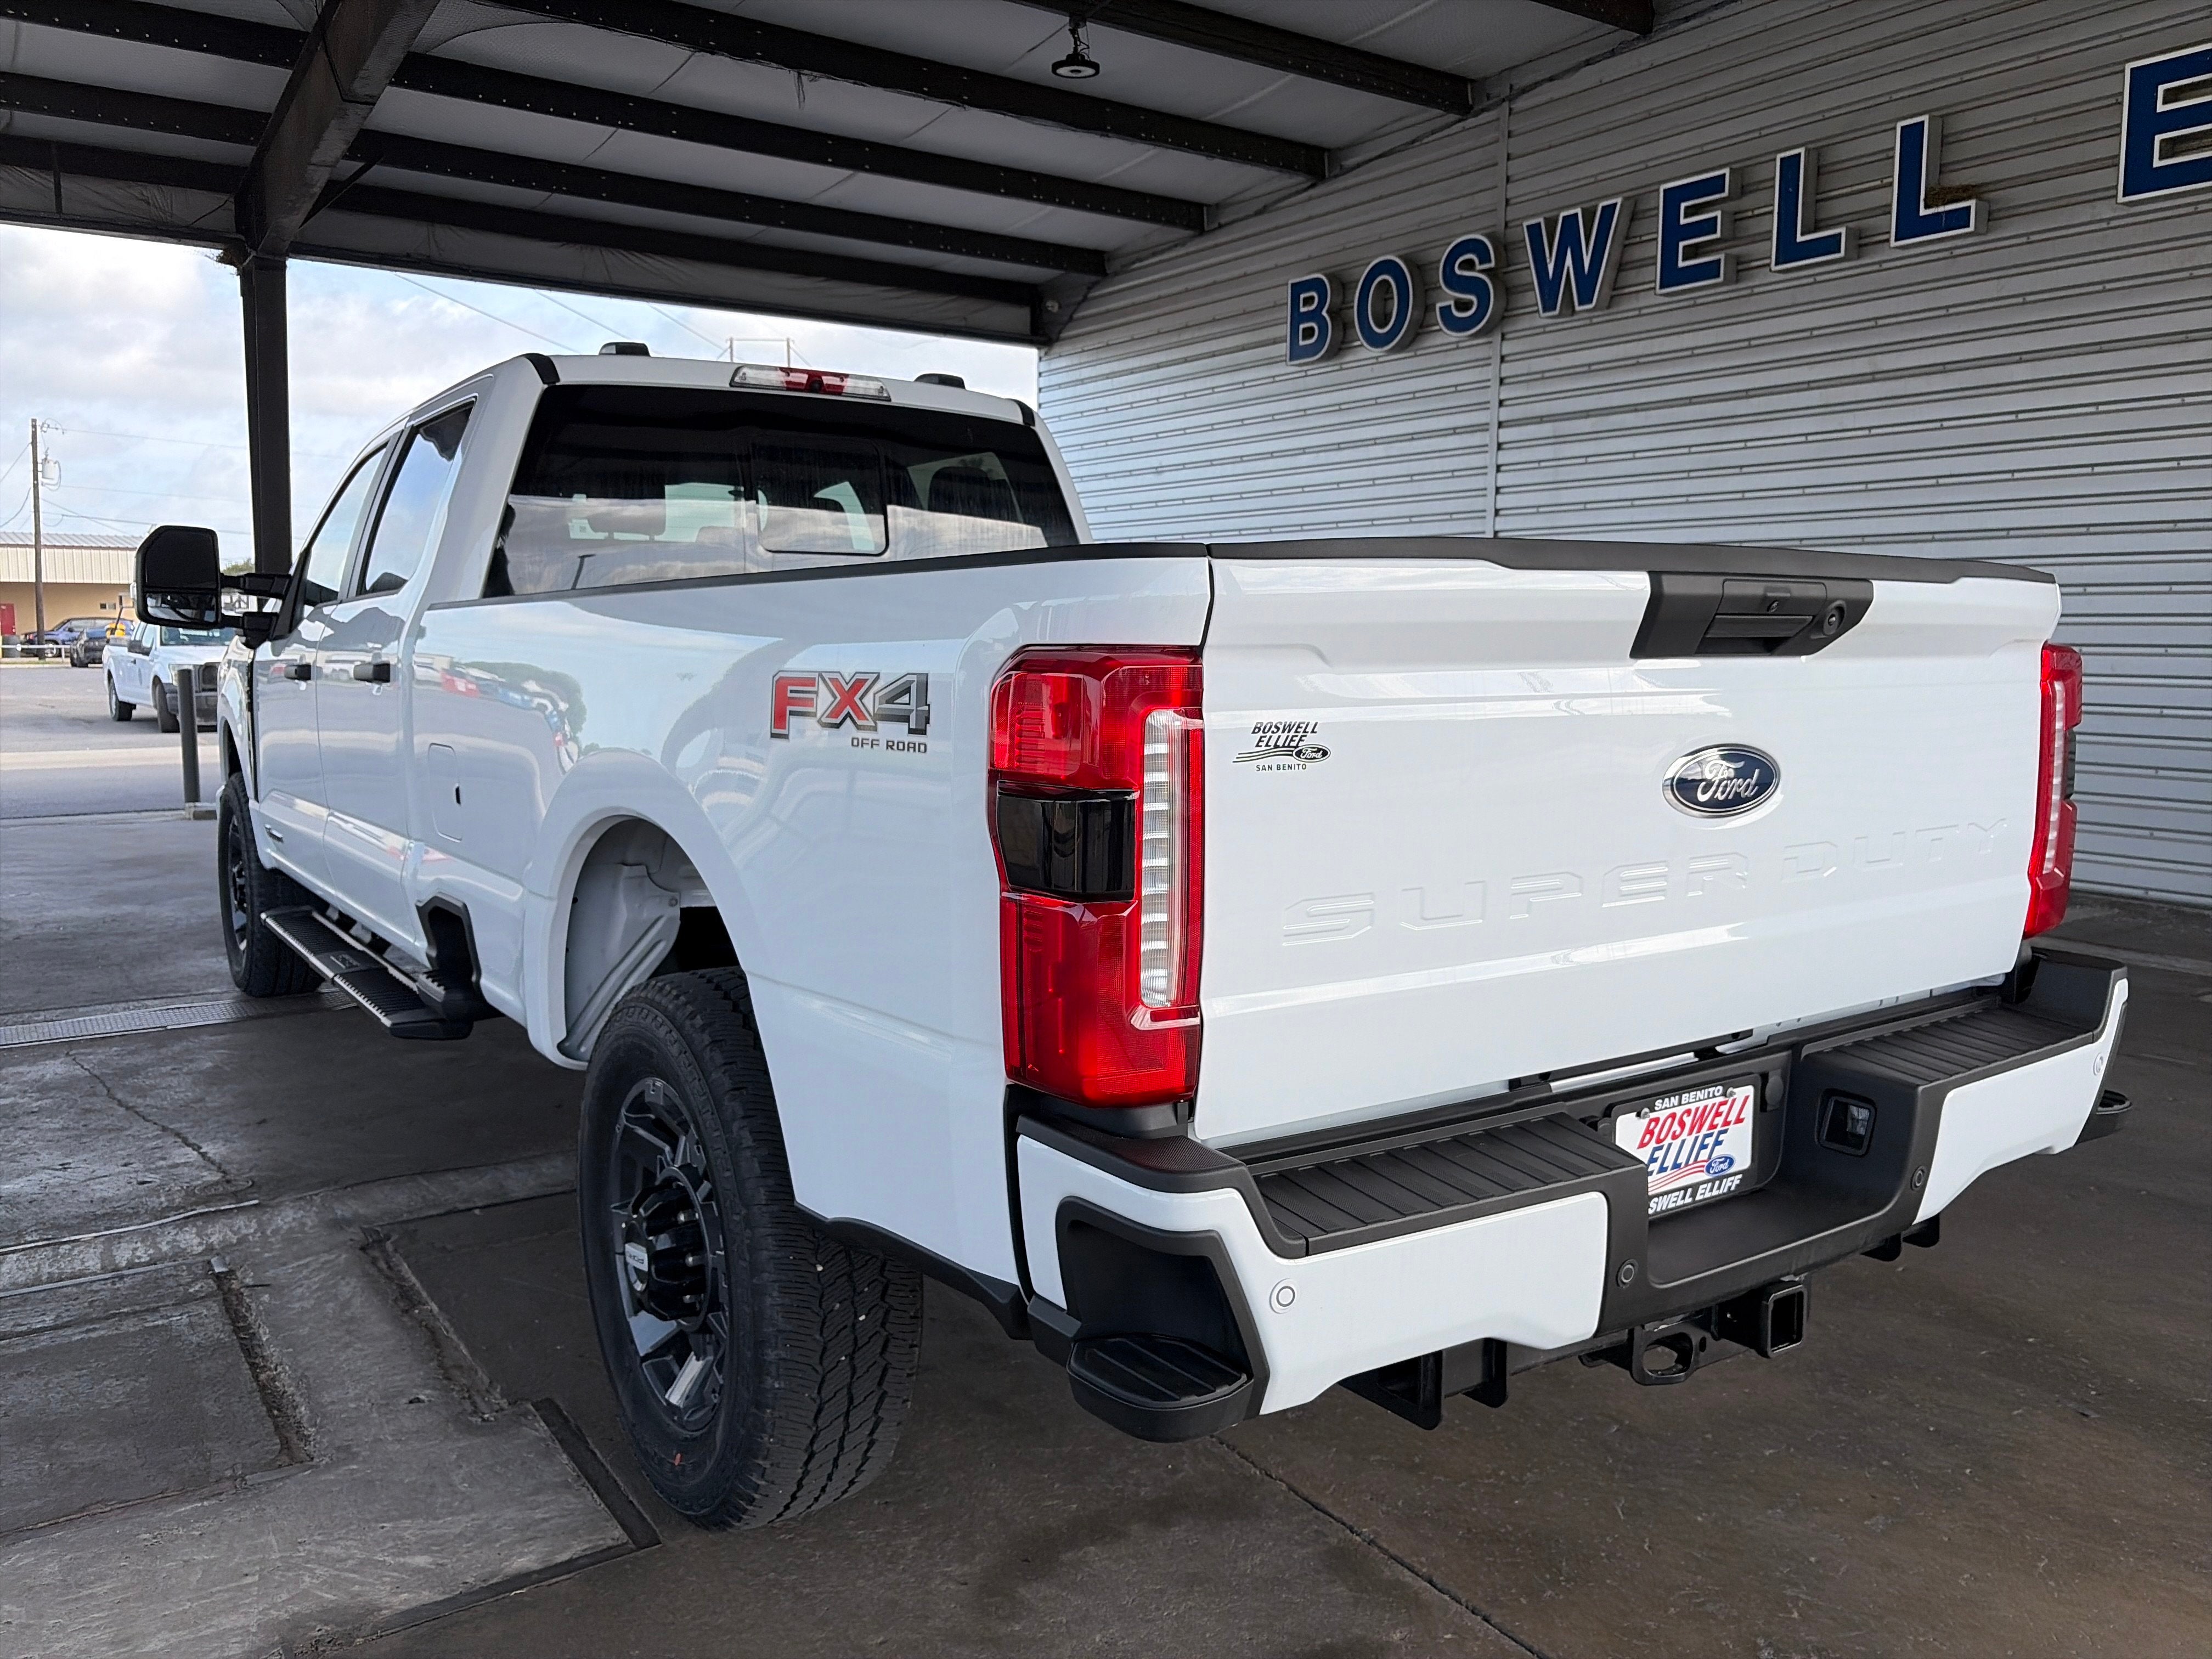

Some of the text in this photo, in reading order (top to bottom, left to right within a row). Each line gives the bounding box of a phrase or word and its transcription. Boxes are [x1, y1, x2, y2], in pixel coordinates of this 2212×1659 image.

[1286, 114, 1983, 365] BOSWELL
[770, 670, 930, 739] FX4
[851, 737, 927, 753] OFF ROAD
[1251, 721, 1319, 734] BOSWELL
[1255, 735, 1307, 748] ELLIFF
[1697, 760, 1759, 802] Ford
[1282, 817, 2007, 946] SUPER DUTY
[1655, 1085, 1724, 1110] SAN BENITO
[1637, 1095, 1750, 1149] BOSWELL
[1646, 1127, 1730, 1177] ELLIFF
[1709, 1157, 1729, 1173] Ford
[1647, 1174, 1743, 1215] SWELL ELLIFF
